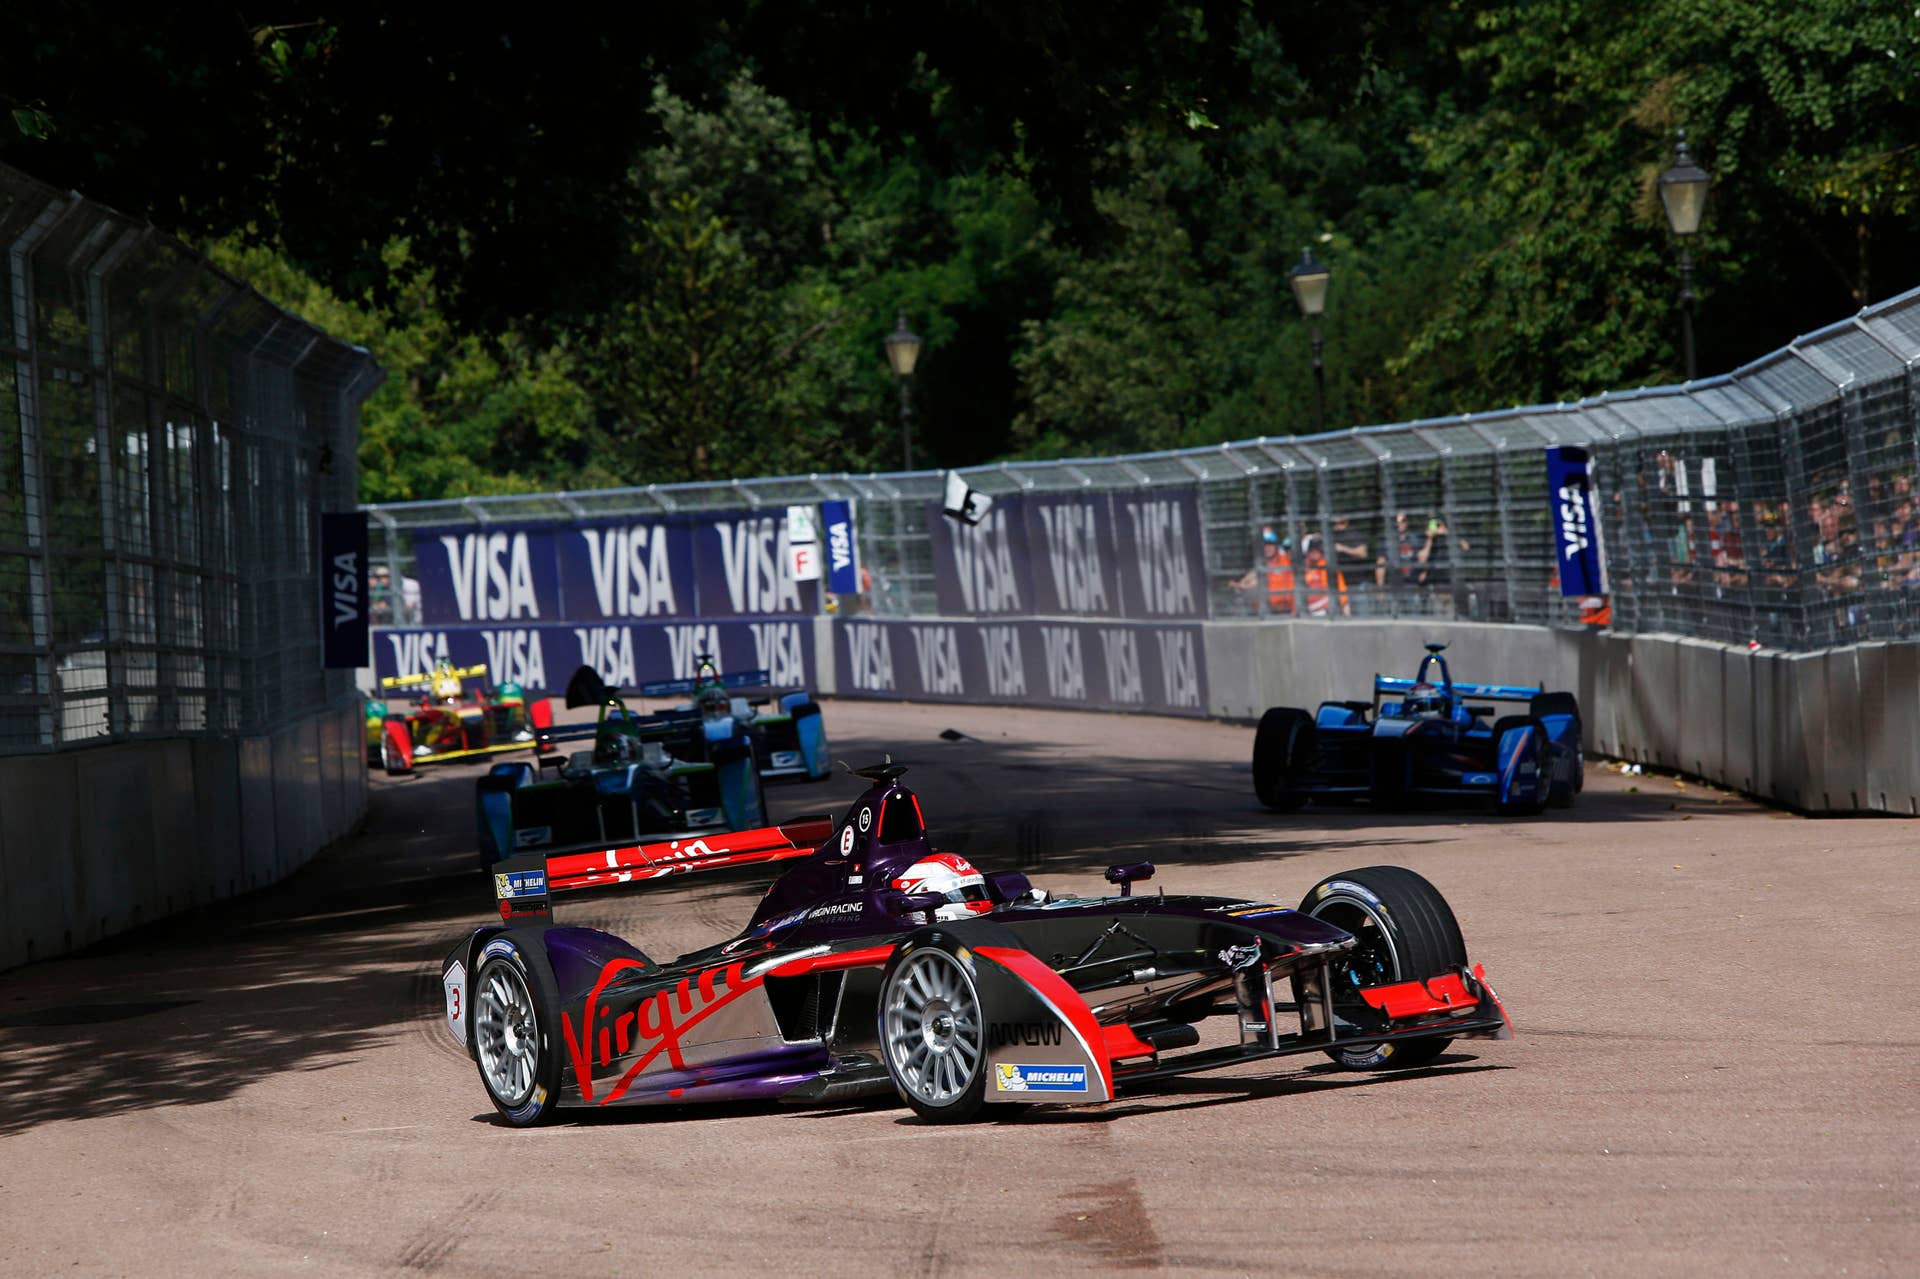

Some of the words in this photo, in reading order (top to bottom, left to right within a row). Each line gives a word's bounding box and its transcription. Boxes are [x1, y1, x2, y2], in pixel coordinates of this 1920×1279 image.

[440, 532, 539, 620] VISA
[582, 525, 677, 617] VISA
[715, 518, 802, 613] VISA
[829, 522, 850, 573] VISA
[947, 509, 1021, 612] VISA
[1039, 504, 1108, 611] VISA
[1127, 501, 1195, 614] VISA
[334, 551, 358, 630] VISA
[481, 629, 546, 690] VISA
[574, 626, 637, 687] VISA
[750, 622, 805, 687] VISA
[844, 624, 896, 690] VISA
[910, 626, 964, 695] VISA
[978, 626, 1026, 696] VISA
[1040, 626, 1086, 700] VISA
[1098, 628, 1144, 703] VISA
[1156, 630, 1200, 707] VISA
[861, 813, 869, 825] 15
[513, 877, 545, 889] MIHELIN
[830, 902, 863, 914] RACING
[452, 987, 460, 1022] 3
[561, 957, 764, 1106] Virgin
[1026, 1071, 1084, 1083] MICHELIN
